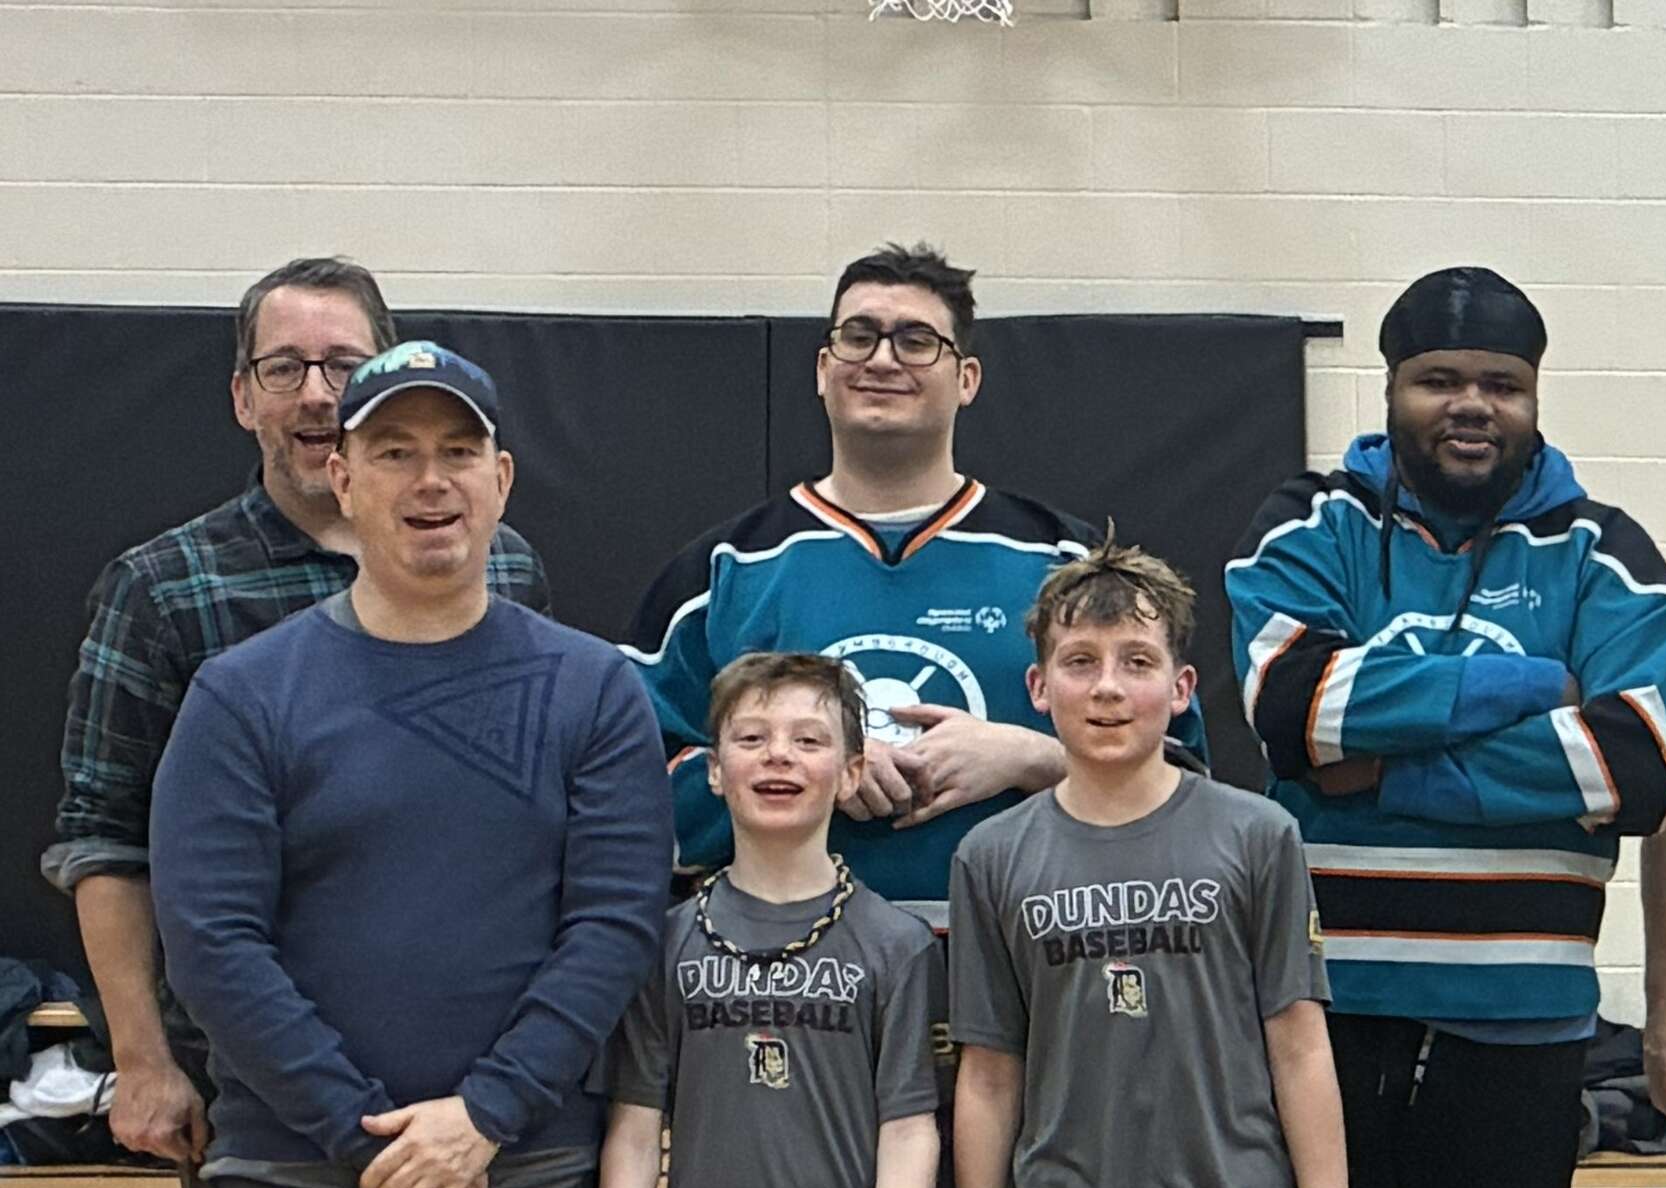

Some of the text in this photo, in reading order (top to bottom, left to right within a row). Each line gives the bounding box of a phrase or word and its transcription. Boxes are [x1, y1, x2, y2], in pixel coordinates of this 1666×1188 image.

[1021, 878, 1220, 939] DUNDAS
[1043, 923, 1201, 966] BASEBALL
[677, 955, 866, 1003] DUNDAS
[686, 999, 853, 1033] BASEBALL
